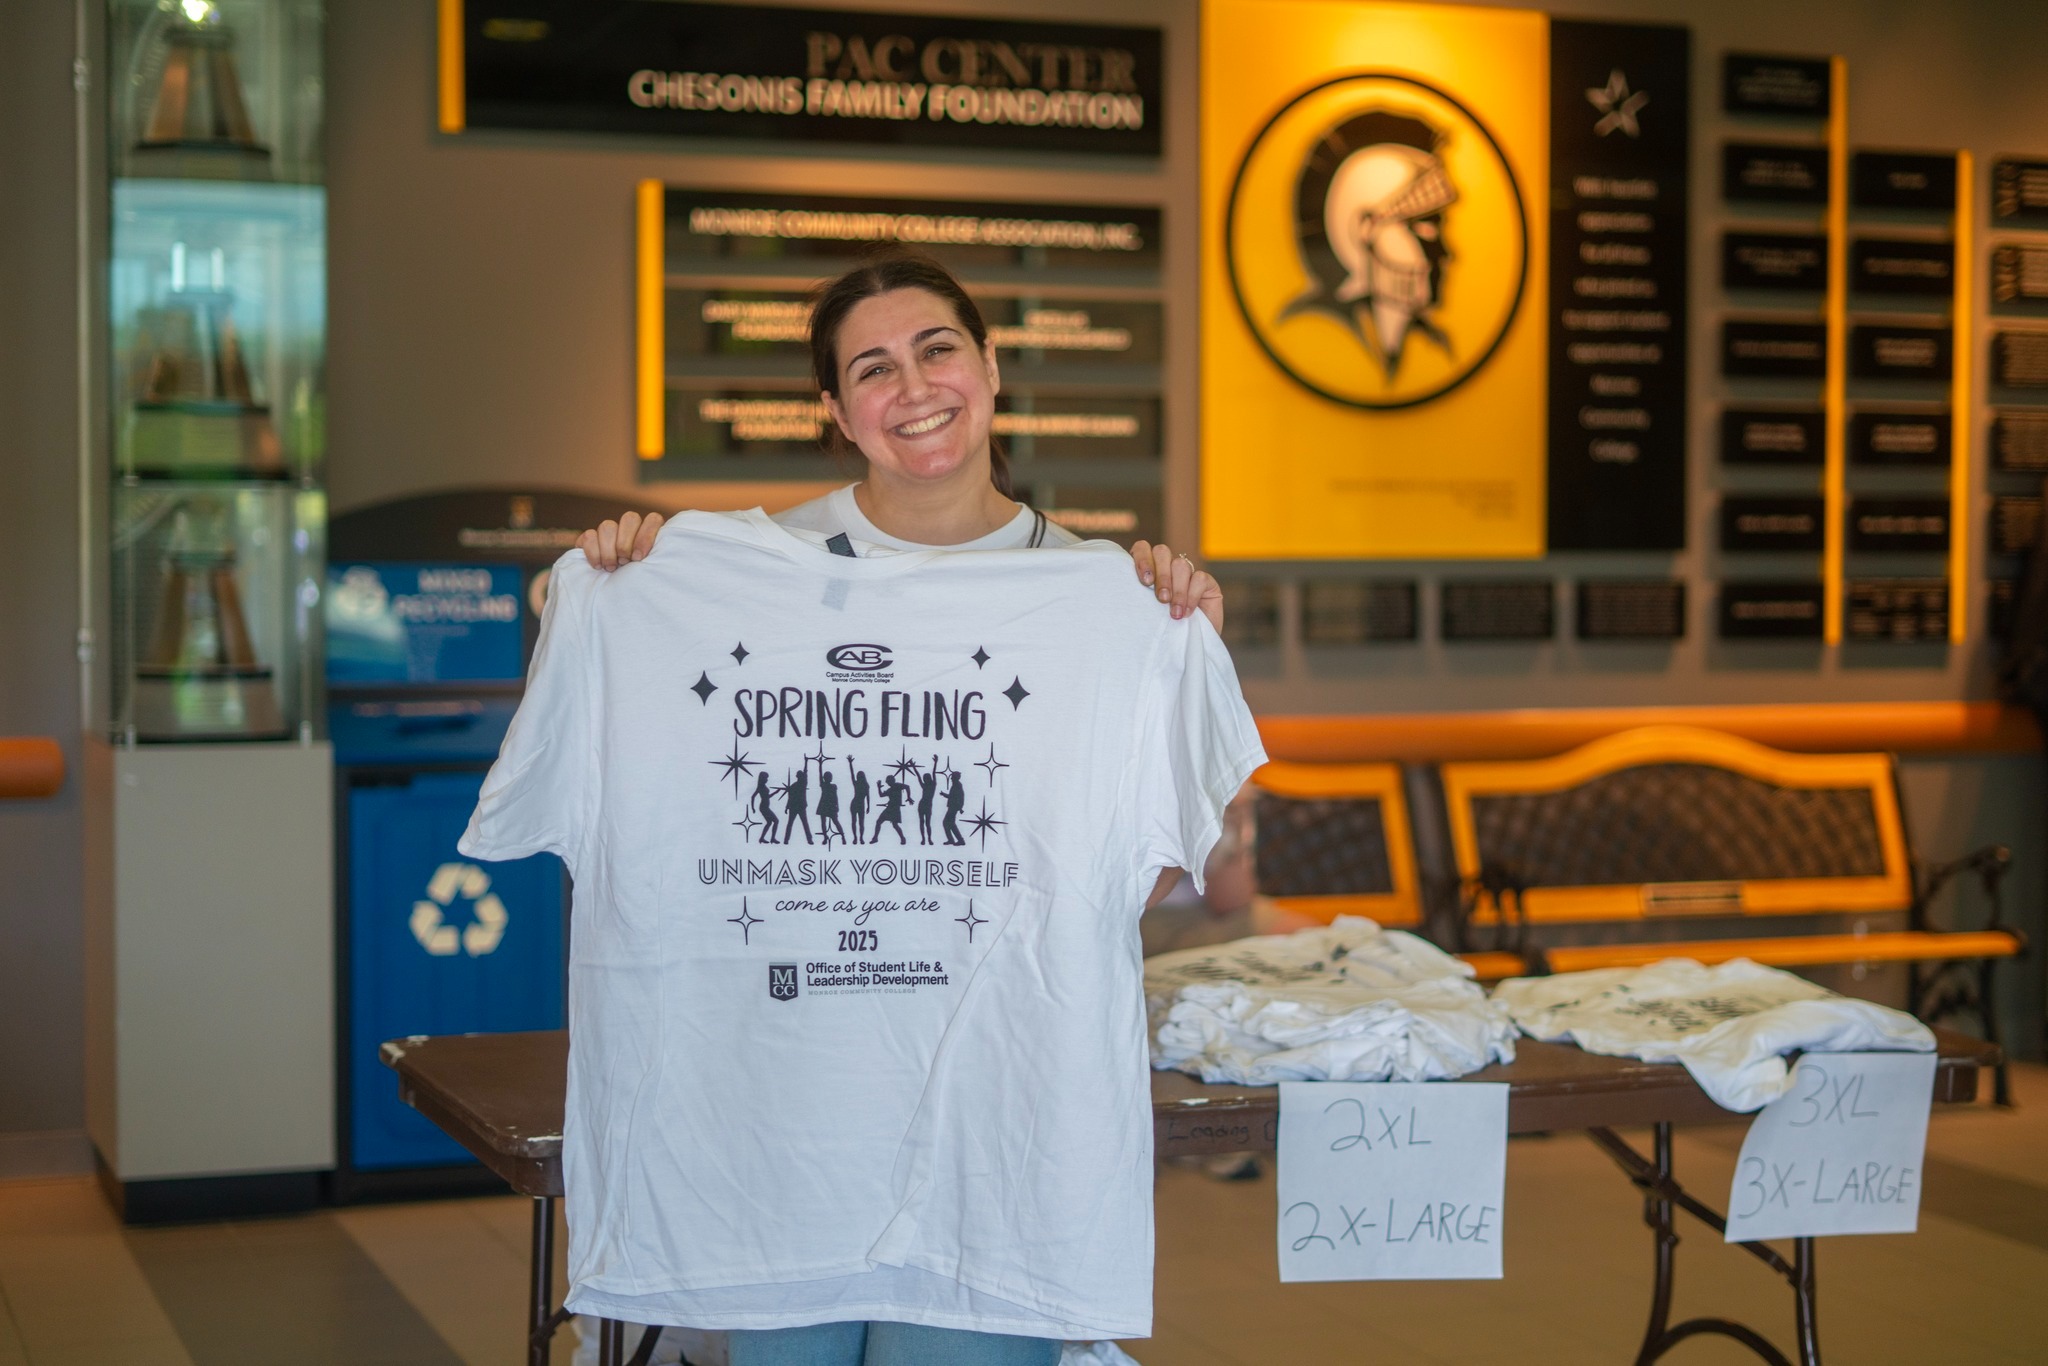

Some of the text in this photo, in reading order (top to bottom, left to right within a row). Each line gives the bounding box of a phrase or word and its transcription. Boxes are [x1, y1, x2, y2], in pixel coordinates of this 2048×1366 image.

[805, 31, 1138, 92] PAC CENTER
[628, 70, 1144, 131] CHESONIS FAMILY FOUNDATION
[394, 594, 517, 622] RECYCLING
[826, 671, 894, 679] Campus Activities Board
[734, 686, 986, 741] SPRING FLING
[699, 859, 1019, 888] UNMASK YOURSELF
[775, 898, 940, 926] come as you are
[838, 930, 878, 952] 2025
[806, 961, 943, 974] Office of Student Life &
[807, 973, 949, 987] Leadership Development
[1789, 1064, 1879, 1128] 3XL
[1324, 1098, 1432, 1152] 2XL
[1737, 1156, 1915, 1220] 3X-LARGE
[1284, 1198, 1497, 1252] 2X-LARGE
